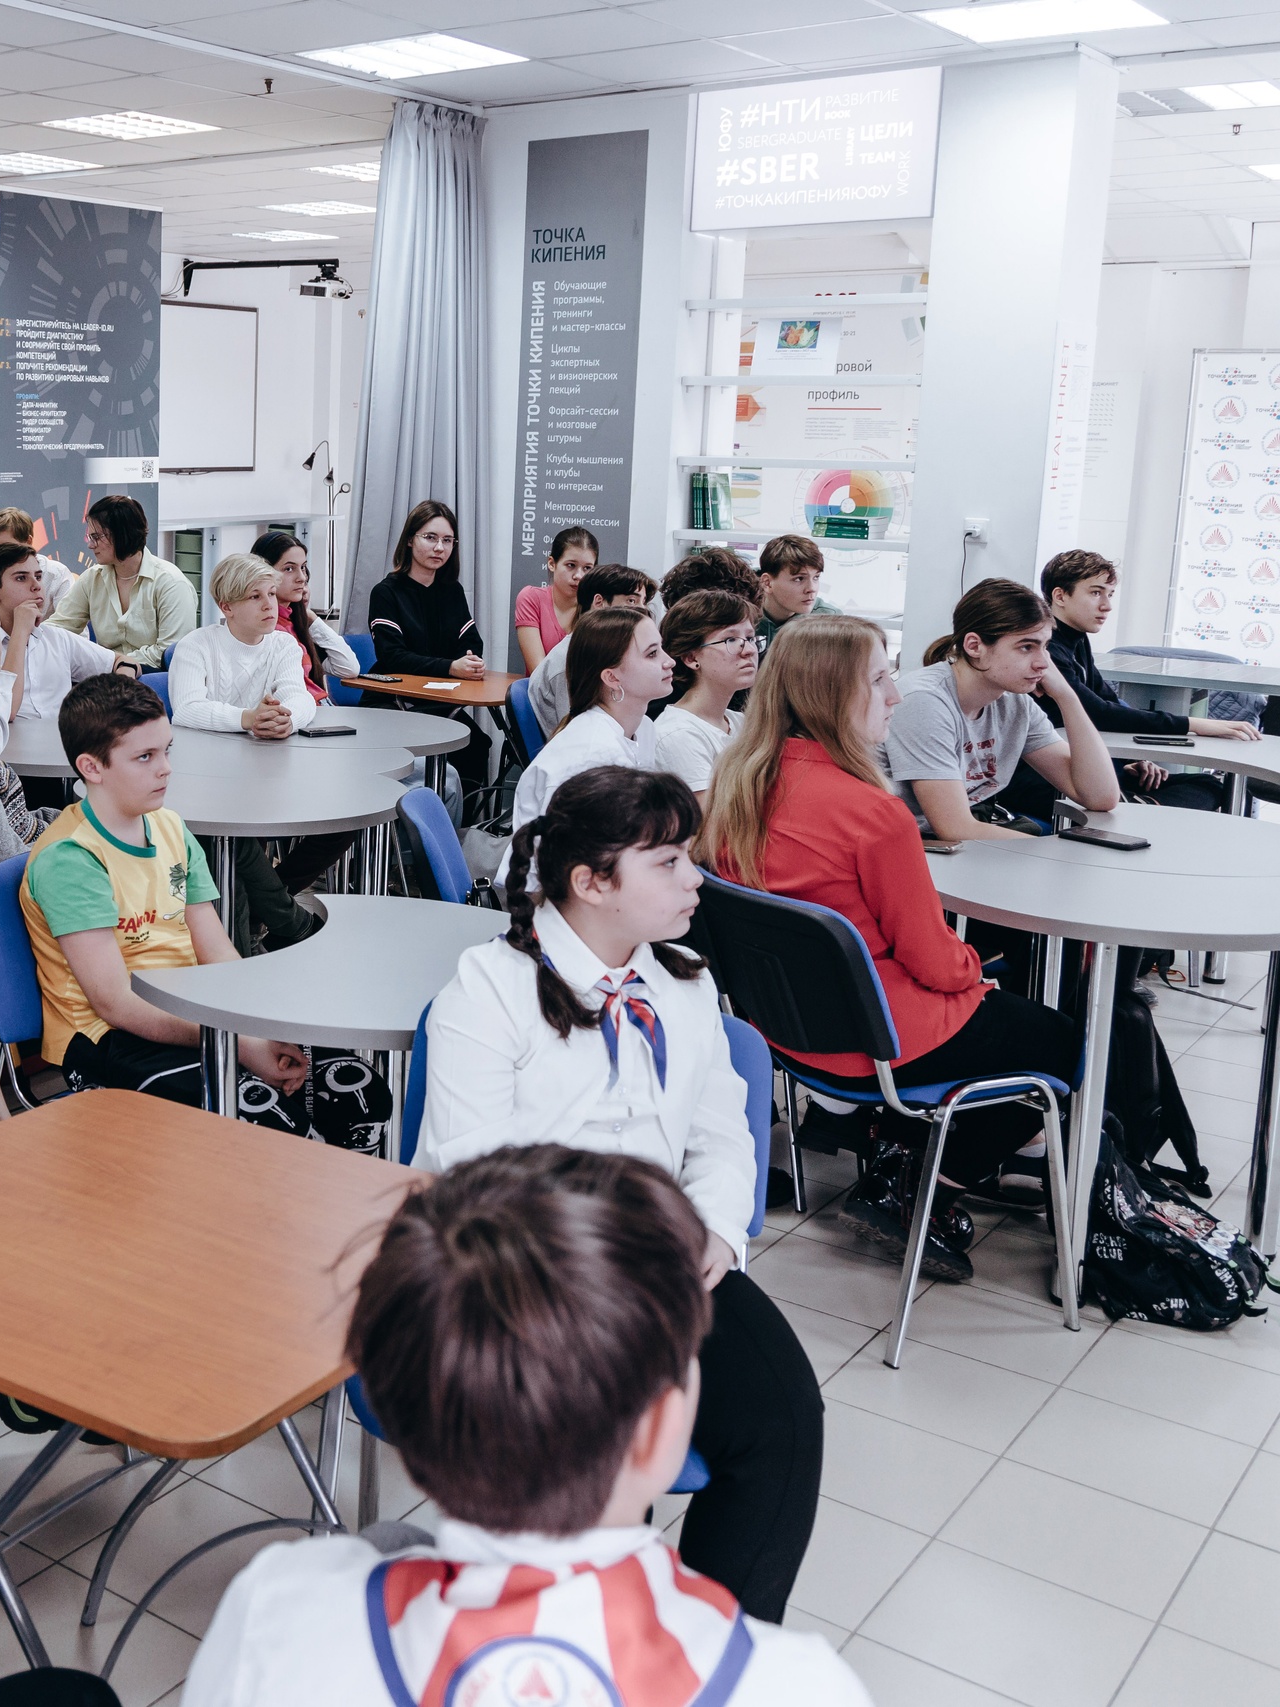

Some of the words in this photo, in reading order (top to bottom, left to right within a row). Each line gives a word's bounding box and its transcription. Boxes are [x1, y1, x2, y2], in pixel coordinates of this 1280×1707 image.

[824, 87, 899, 108] РАЗВИТИЕ
[739, 96, 822, 127] #НТИ
[824, 109, 851, 120] BOOK
[718, 106, 733, 153] ЮФУ
[860, 121, 914, 143] ЦЕЛИ
[737, 127, 842, 150] SBERGRADUATE
[845, 126, 855, 165] LIBRARY
[859, 150, 896, 165] TEAM
[715, 152, 820, 187] #SBER
[896, 150, 911, 197] WORK
[715, 184, 892, 210] #ТОЧКАКИПЕНИЯЮФУ
[533, 227, 585, 244] ТОЧКА
[531, 244, 606, 264] КИПЕНИЯ
[554, 280, 607, 293] Обучающие
[553, 294, 605, 306] программы,
[553, 308, 593, 319] тренинги
[16, 319, 71, 330] ЗАРЕГИСТРИРУЙТЕСЬ
[81, 323, 114, 332] LEADER-ID.RU
[530, 280, 546, 363] КИПЕНИЯ
[552, 323, 558, 331] и
[561, 322, 626, 332] мастер-классы
[16, 329, 46, 340] ПРОЙДИТЕ
[47, 332, 84, 341] ДИАГНОСТИКУ
[22, 341, 60, 351] СФОРМИРУЙТЕ
[62, 341, 75, 351] СВОЙ
[76, 344, 101, 352] ПРОФИЛЬ
[551, 343, 580, 355] Циклы
[16, 351, 56, 360] КОМПЕТЕНЦИЙ
[16, 362, 44, 371] ПОЛУЧИТЕ
[45, 363, 88, 372] РЕКОМЕНДАЦИИ
[551, 358, 600, 369] экспертных
[836, 359, 872, 374] ровой
[16, 373, 24, 381] ПО
[25, 374, 54, 382] РАЗВИТИЮ
[55, 374, 85, 383] ЦИФРОВЫХ
[550, 372, 555, 380] и
[558, 371, 618, 382] визионерских
[549, 384, 581, 396] лекций
[807, 389, 860, 402] профиль
[527, 369, 542, 426] ТОЧКИ
[549, 406, 619, 417] Форсайт-сессии
[1050, 339, 1070, 490] HEALTHNET
[548, 421, 553, 429] и
[556, 420, 597, 431] мозговые
[547, 433, 582, 444] штурмы
[22, 442, 63, 450] ТЕХНОЛОГИЧЕСКИЙ
[546, 454, 574, 466] Клубы
[577, 456, 624, 465] мышления
[546, 469, 552, 477] и
[554, 467, 580, 478] клубы
[545, 482, 556, 491] по
[558, 482, 604, 492] интересам
[521, 431, 539, 557] МЕРОПРИЯТИЯ
[544, 502, 595, 513] Менторские
[544, 516, 549, 524] и
[552, 516, 620, 528] коучинг-сессии
[1095, 1246, 1124, 1262] CLUB
